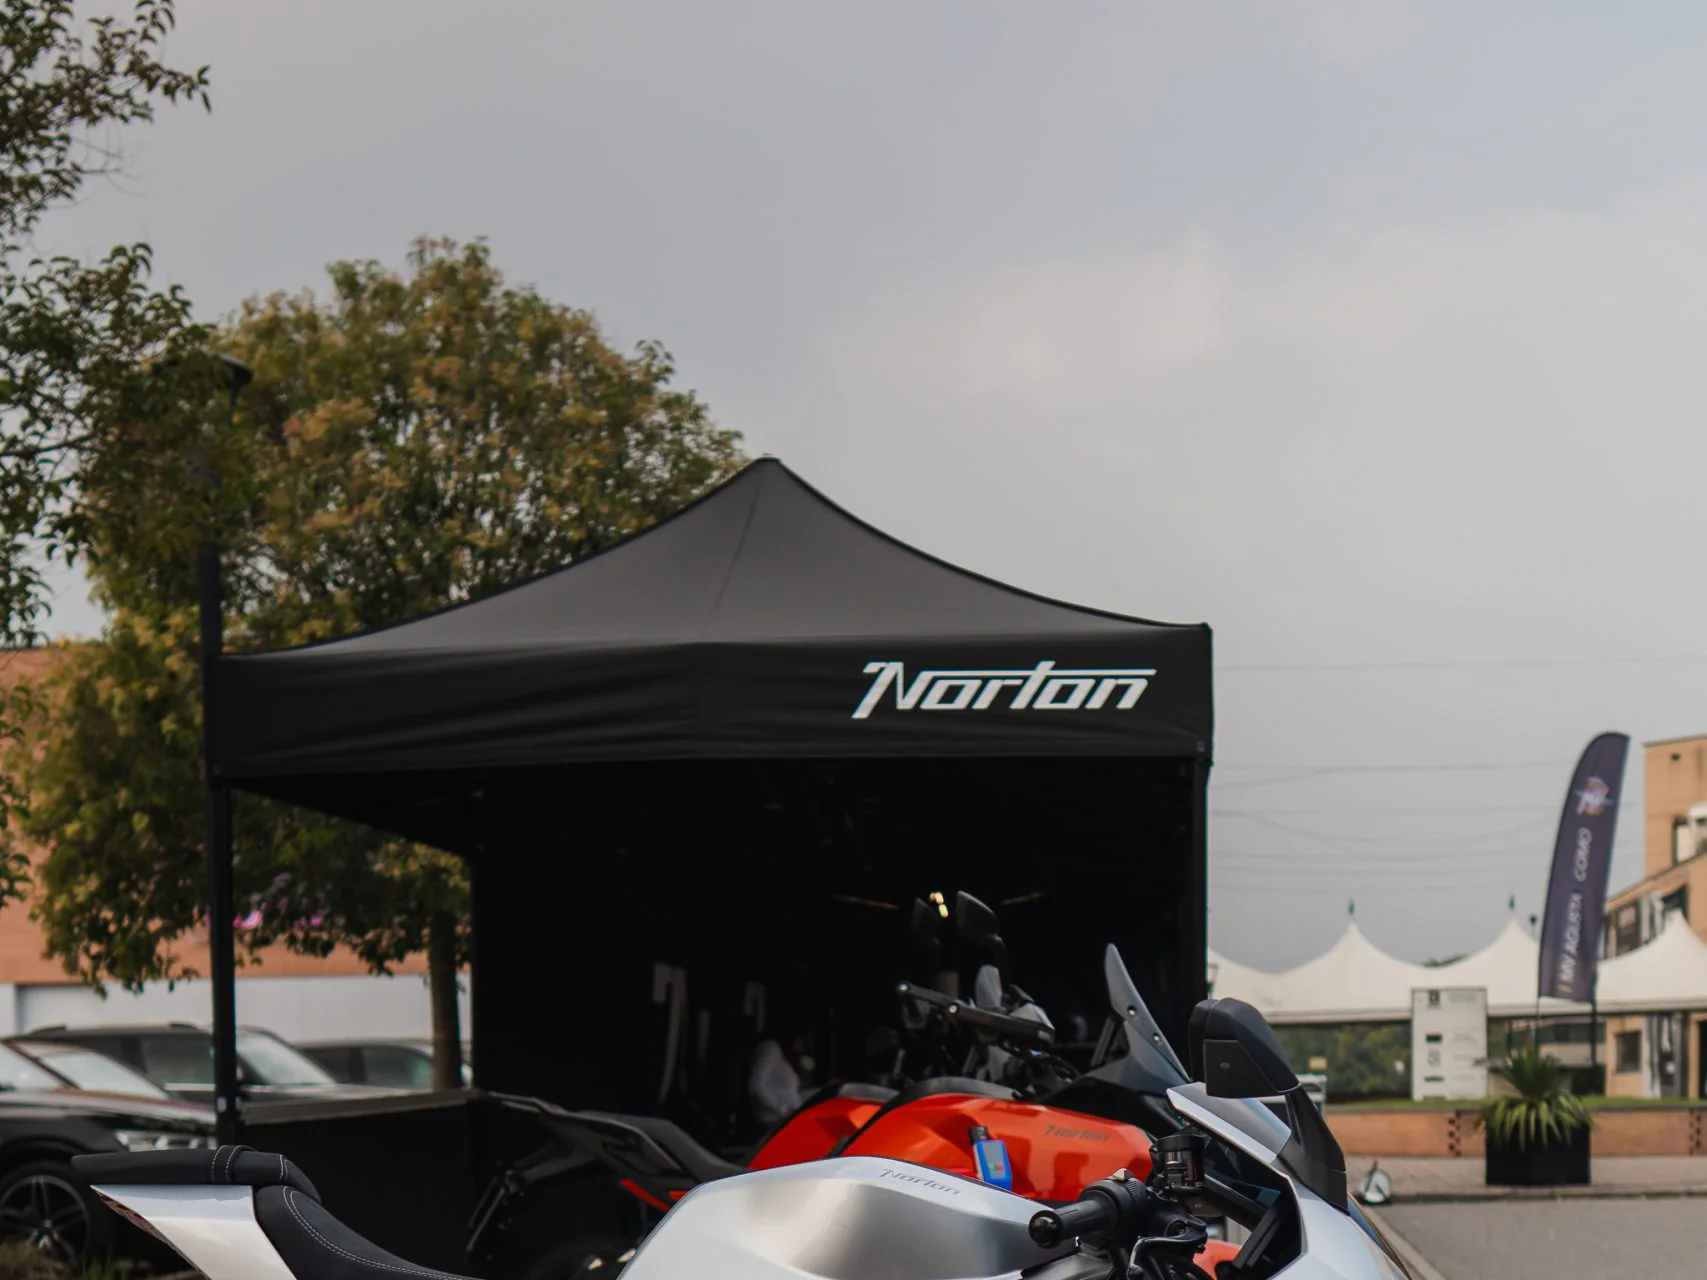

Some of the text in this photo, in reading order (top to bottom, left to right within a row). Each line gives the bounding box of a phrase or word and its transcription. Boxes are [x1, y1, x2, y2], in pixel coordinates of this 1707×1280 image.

[851, 660, 1158, 719] Norton
[1574, 827, 1593, 882] COMO
[1043, 1124, 1110, 1143] Norton
[879, 1168, 961, 1195] Norton
